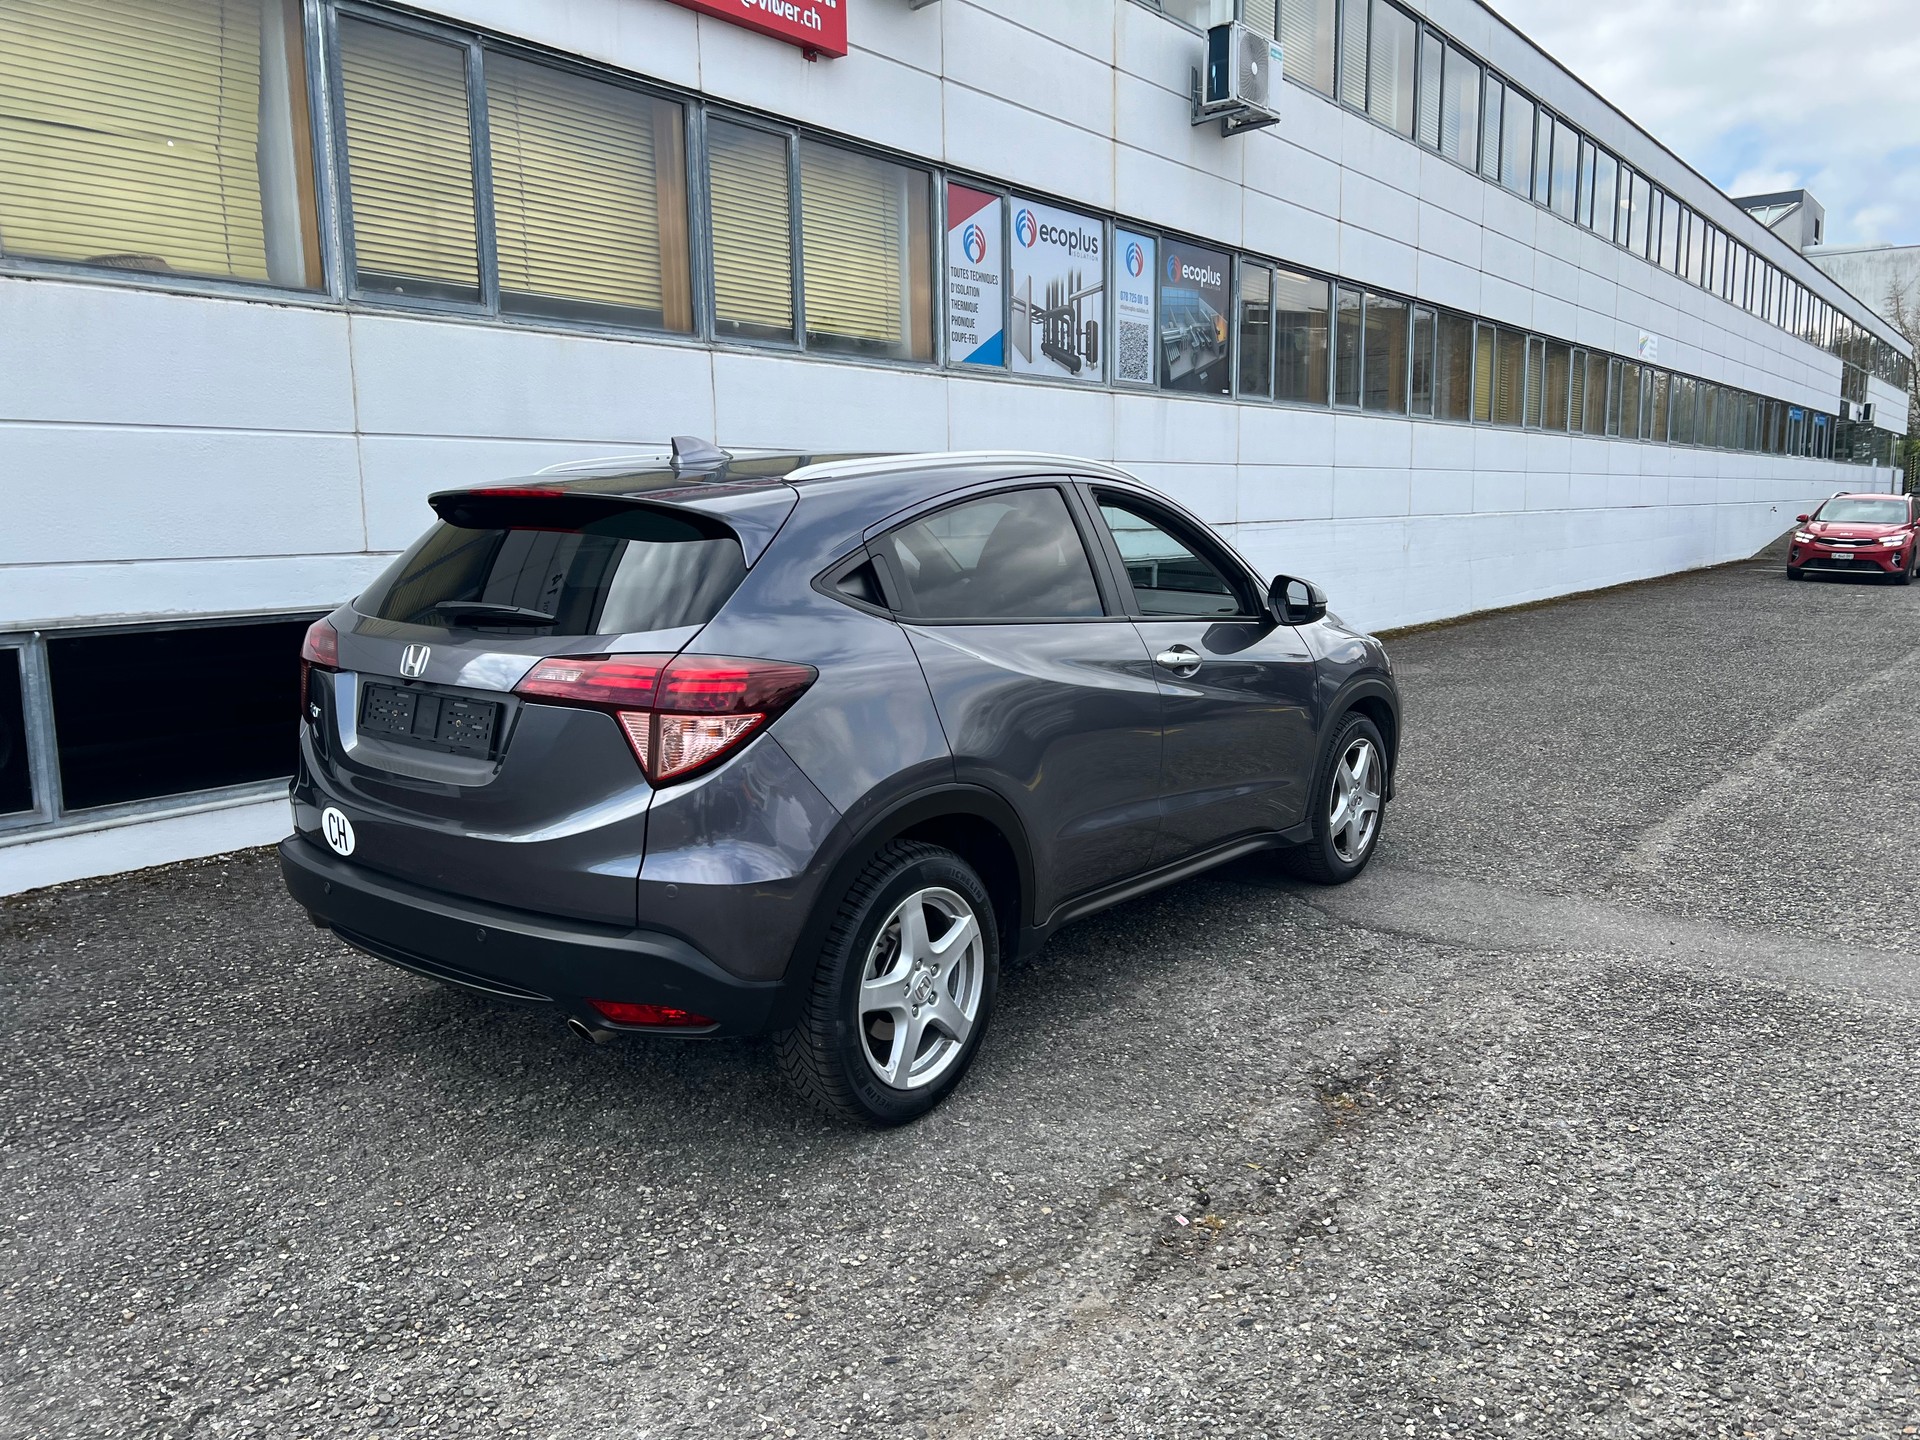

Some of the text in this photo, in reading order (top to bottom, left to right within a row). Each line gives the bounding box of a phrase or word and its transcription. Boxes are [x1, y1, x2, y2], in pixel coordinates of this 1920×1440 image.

[1039, 223, 1098, 255] ecoplus
[950, 266, 999, 286] TOUTES TECHNIQUES
[1182, 263, 1221, 288] ecoplus
[950, 282, 980, 298] D'ISOLATION
[950, 298, 979, 314] THERMIQUE
[951, 314, 976, 329] PHONIQUE
[951, 331, 979, 345] COUPE-FEU
[327, 812, 349, 852] CH
